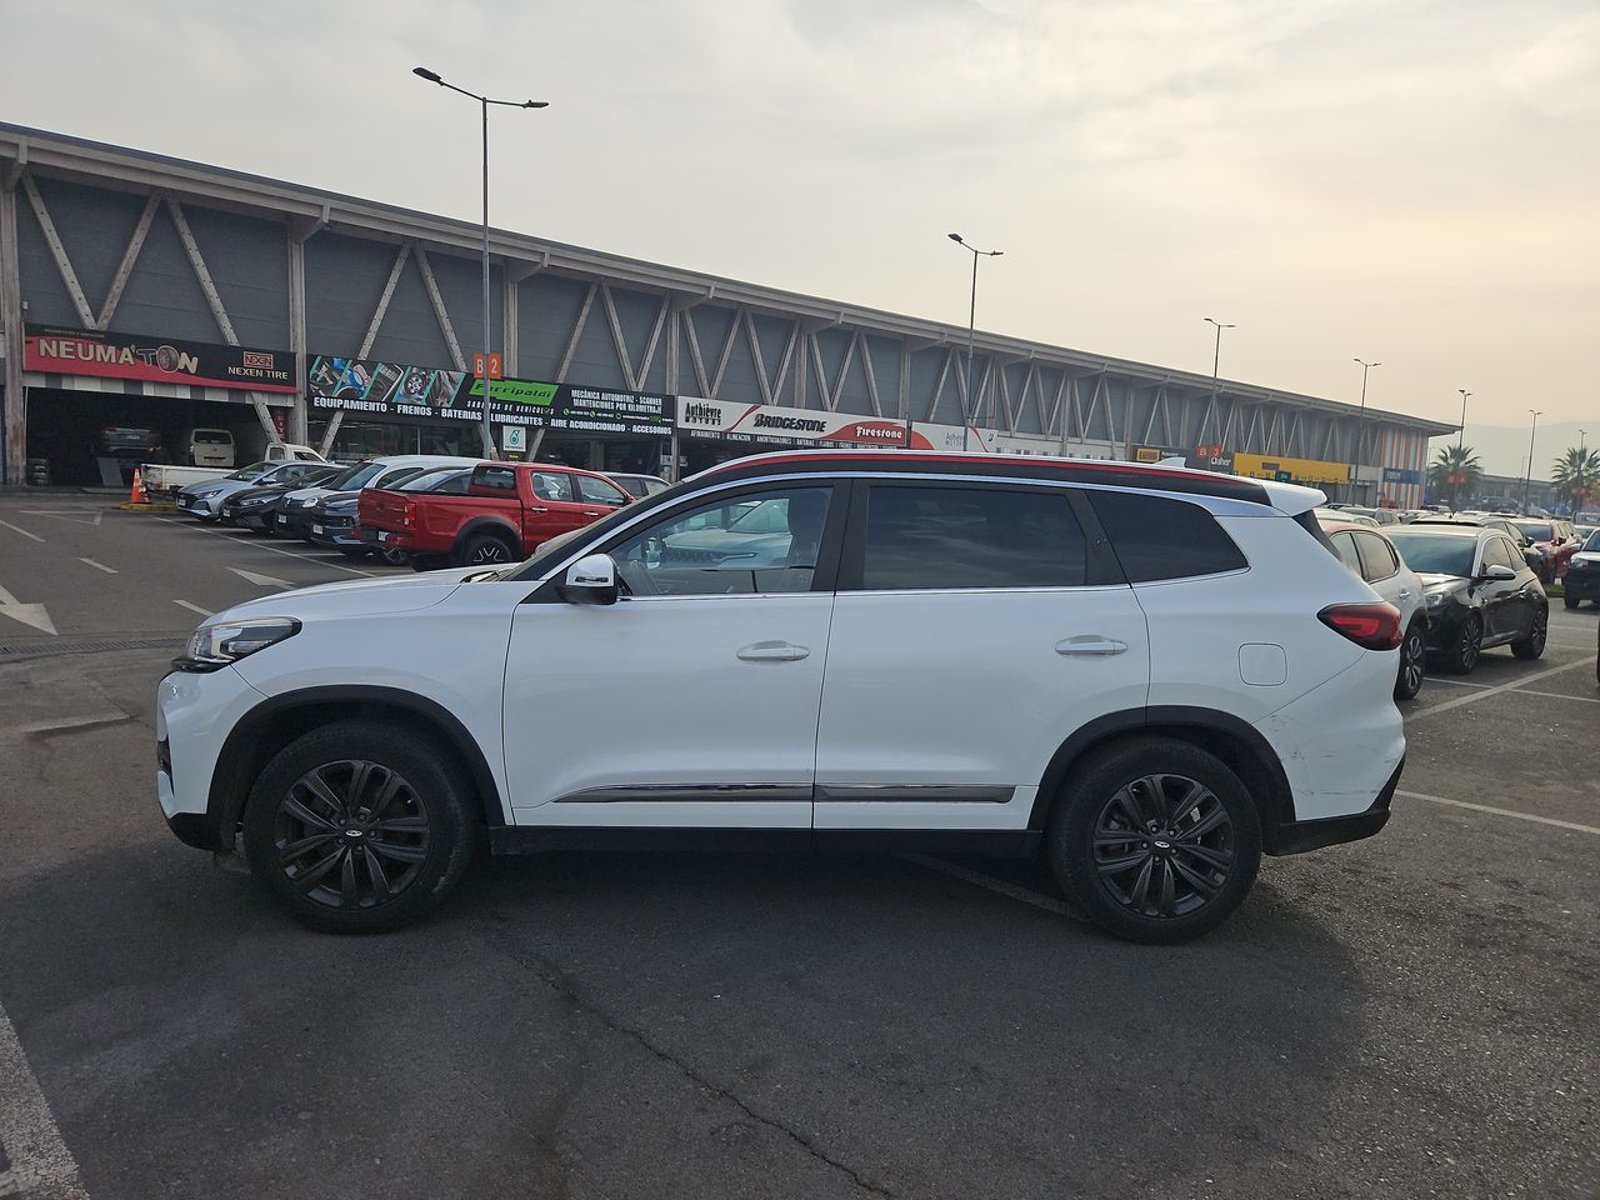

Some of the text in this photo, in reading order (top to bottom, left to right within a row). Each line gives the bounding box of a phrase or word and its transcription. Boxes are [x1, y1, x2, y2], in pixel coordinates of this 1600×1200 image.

[228, 366, 289, 380] NEXEN TIRE
[477, 358, 498, 374] B 2
[475, 383, 552, 398] Frripaldi
[313, 396, 673, 435] EQUIPAMIENTO FRENOS BATERIAS LUBRICANTES AIRE ACONDICIONADO ACCESORIOS
[753, 413, 828, 433] BRIDGESTONE
[856, 425, 903, 439] Firestone
